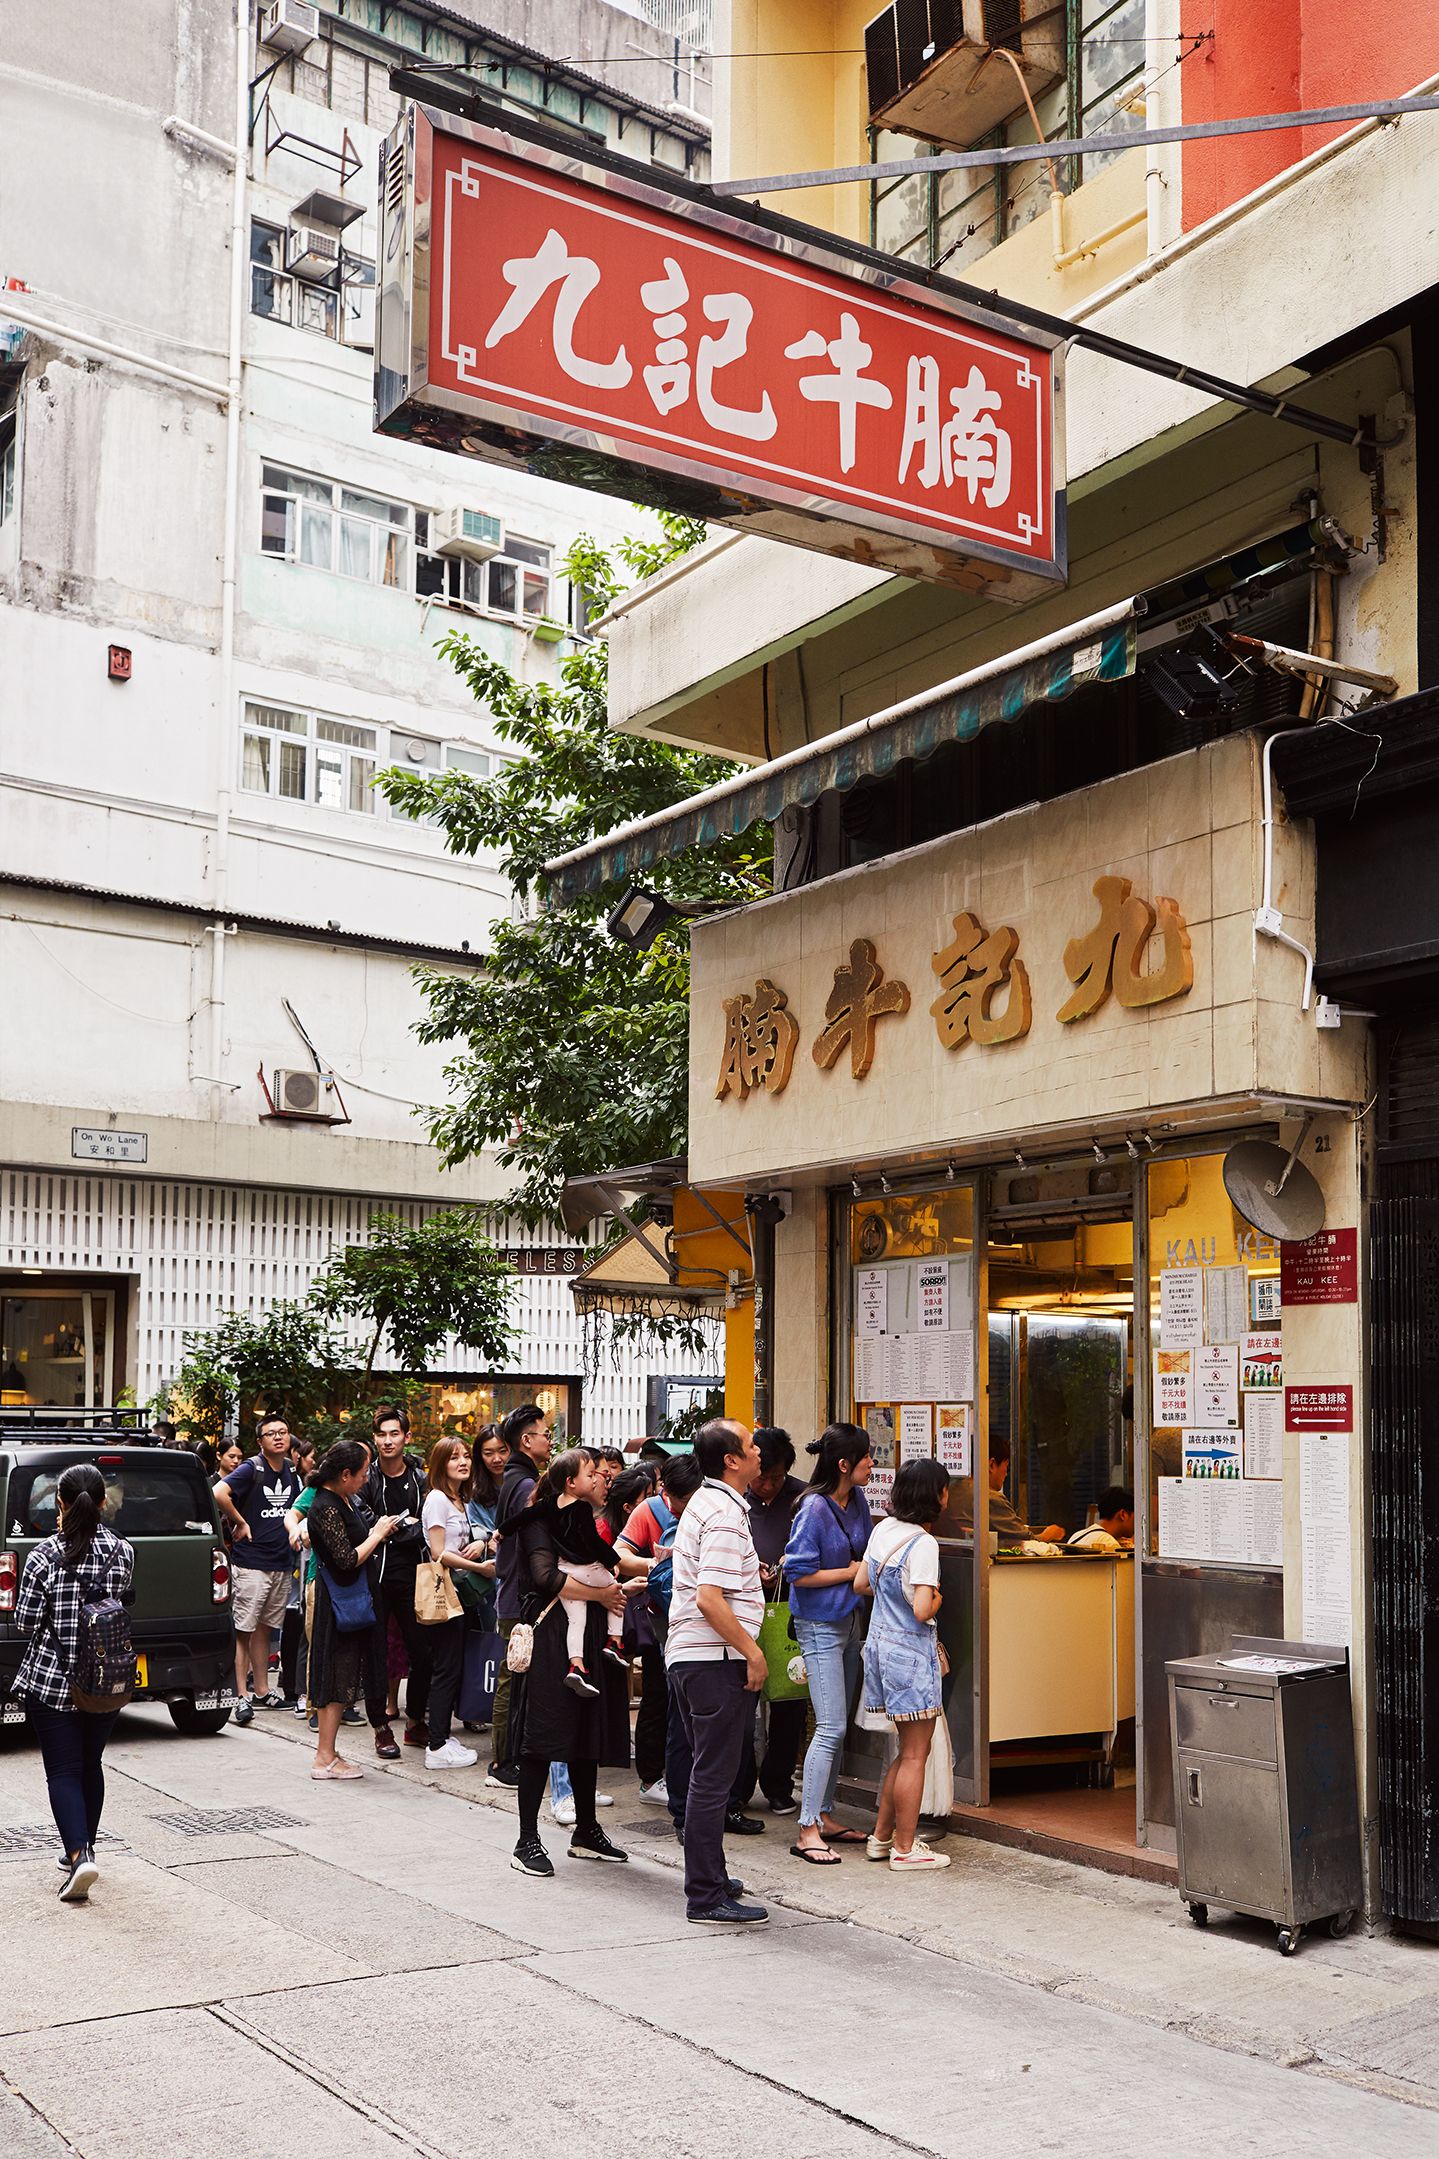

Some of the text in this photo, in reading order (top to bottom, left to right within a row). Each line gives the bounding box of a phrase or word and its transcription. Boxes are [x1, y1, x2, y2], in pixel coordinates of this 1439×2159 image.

[485, 228, 1011, 508] 九記牛腩
[99, 1134, 113, 1142] Wo
[118, 1136, 139, 1144] Lane
[1315, 1135, 1332, 1152] 21
[89, 1145, 129, 1157] 安和里
[1167, 1237, 1215, 1268] KAU
[920, 1276, 946, 1286] SORRY!
[1321, 1276, 1338, 1284] KEE
[1247, 1338, 1282, 1348] 請在左邊
[1162, 1389, 1186, 1397] 千元大鈔
[943, 1442, 962, 1450] 千元大鈔
[880, 1488, 891, 1496] ONL
[261, 1507, 291, 1518] adida
